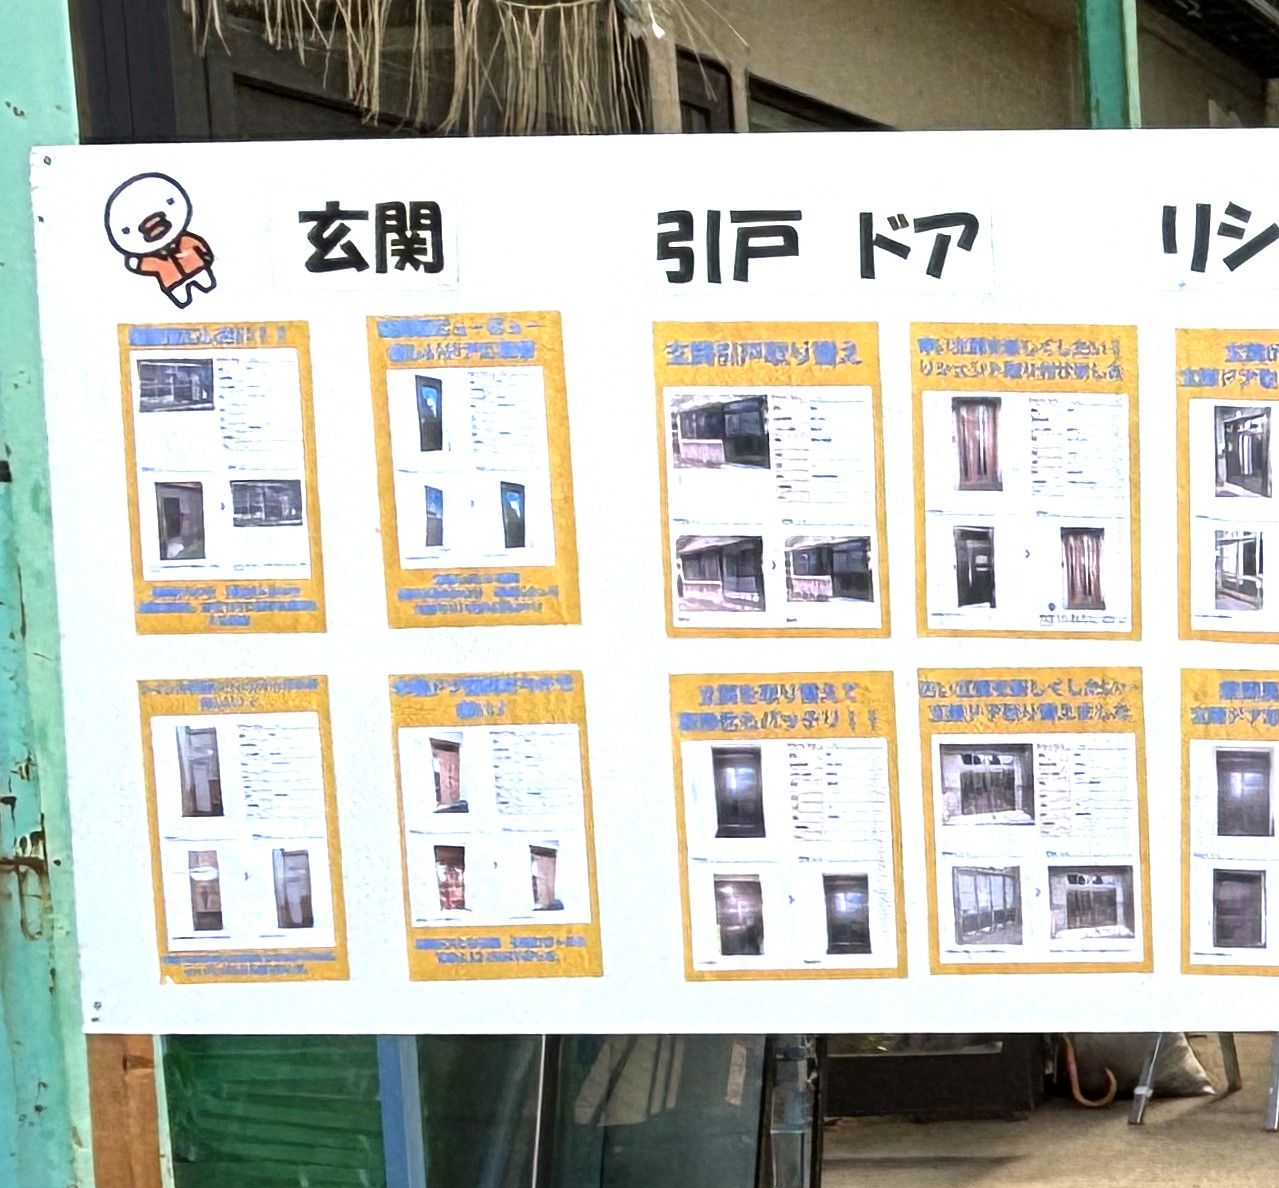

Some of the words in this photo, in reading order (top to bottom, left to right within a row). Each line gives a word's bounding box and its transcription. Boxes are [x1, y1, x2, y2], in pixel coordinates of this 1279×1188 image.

[299, 200, 444, 274] 玄関
[657, 209, 802, 283] 引戸
[860, 212, 979, 279] ドア
